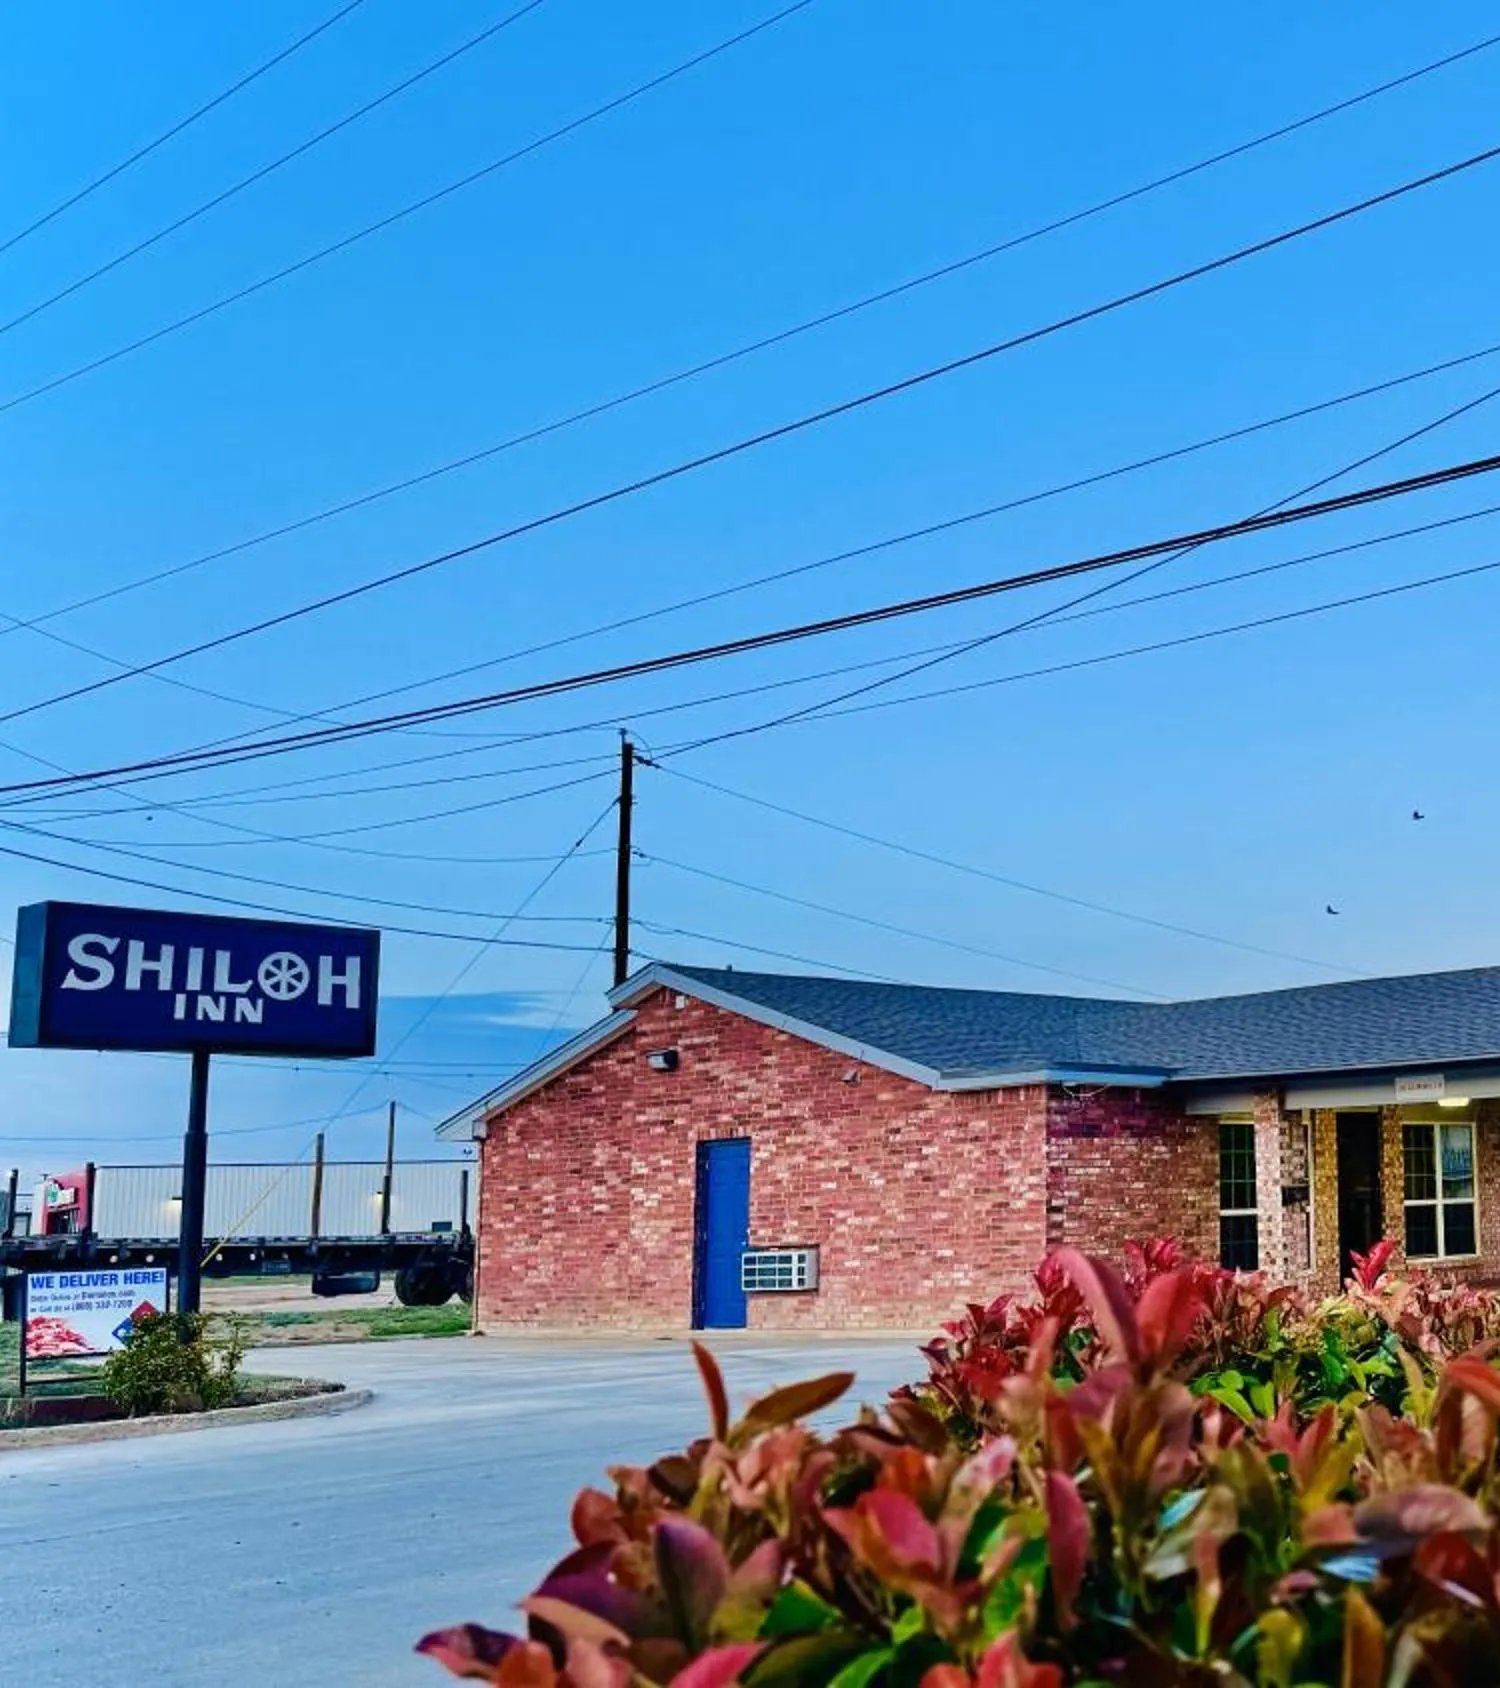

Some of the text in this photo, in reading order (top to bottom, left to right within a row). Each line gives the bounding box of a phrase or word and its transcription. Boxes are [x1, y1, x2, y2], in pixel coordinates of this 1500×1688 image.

[60, 933, 361, 1009] SHILOH
[173, 993, 264, 1024] INN
[31, 1271, 165, 1289] WE DELIVER HERE!
